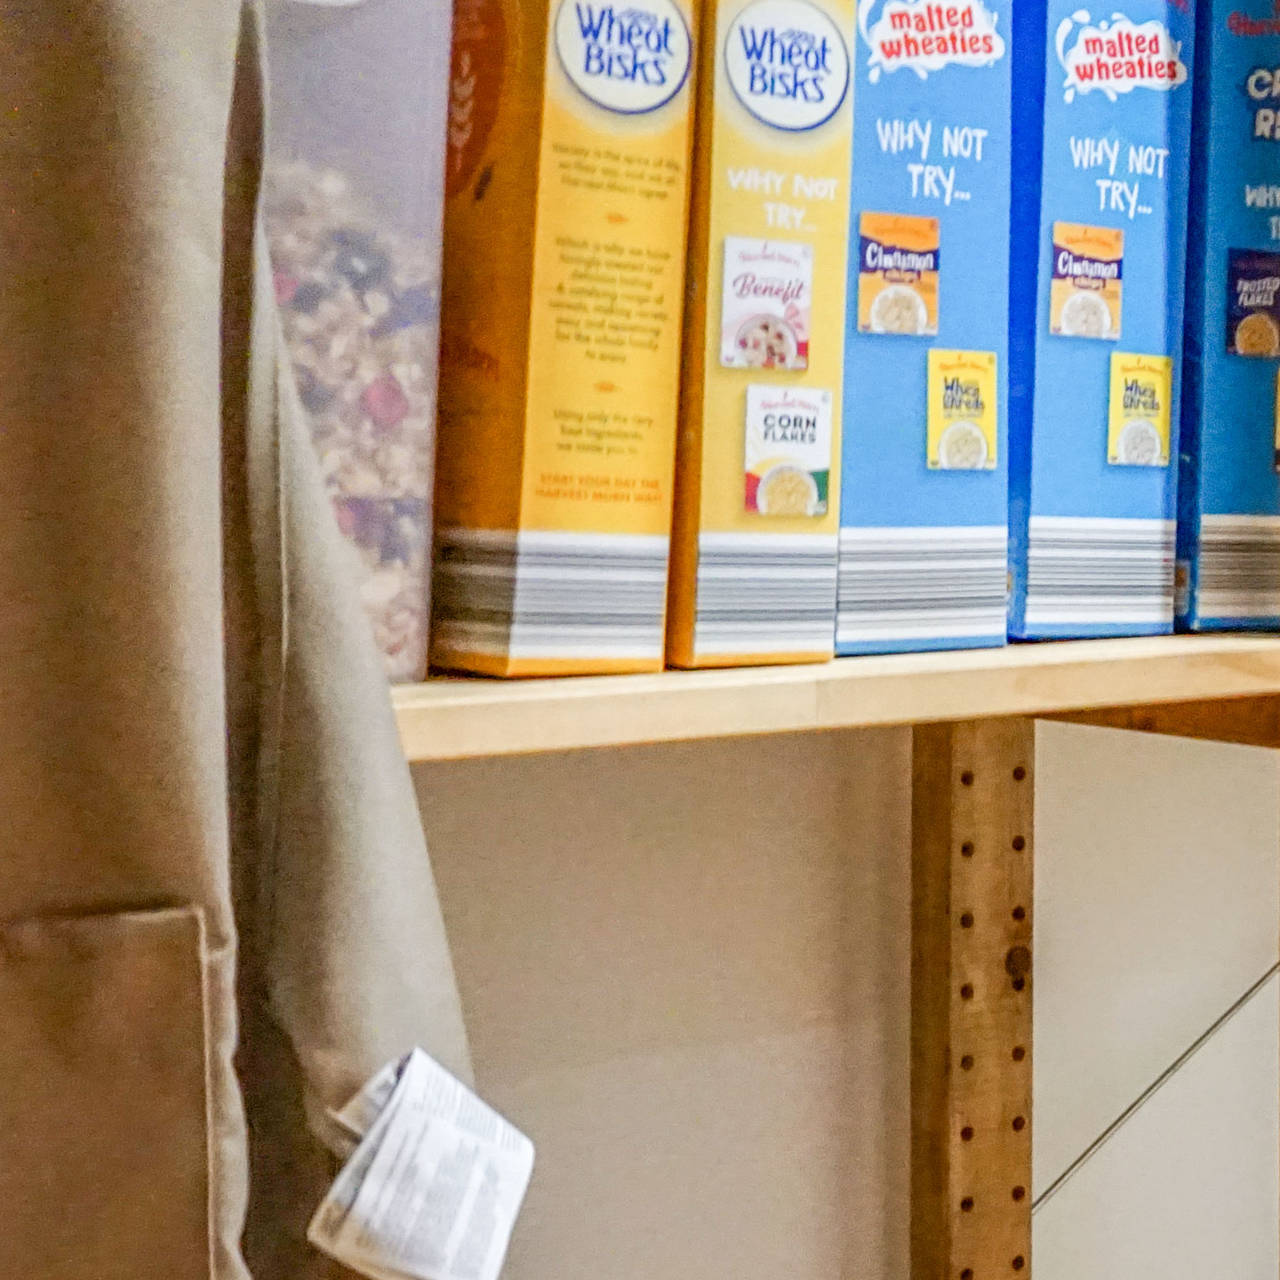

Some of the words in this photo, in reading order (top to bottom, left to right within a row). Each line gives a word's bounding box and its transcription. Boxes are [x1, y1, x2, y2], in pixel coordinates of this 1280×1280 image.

[575, 2, 674, 56] Wheat
[890, 5, 972, 35] malted
[739, 25, 833, 74] Wheat
[880, 27, 993, 60] wheaties
[1084, 32, 1160, 58] malted
[584, 42, 667, 86] Bisks
[1075, 56, 1177, 82] wheaties
[748, 62, 825, 103] Bisks
[876, 118, 932, 160] WHY
[942, 126, 988, 161] NOT
[1070, 136, 1119, 175] WHY
[1129, 146, 1169, 179] NOT
[726, 167, 785, 195] WHY
[793, 174, 839, 201] NOT
[865, 242, 934, 271] Cinnamon
[1057, 250, 1118, 279] Cinnamon
[732, 270, 804, 303] Benefit
[763, 412, 817, 430] CORN
[763, 429, 817, 445] FLAKES
